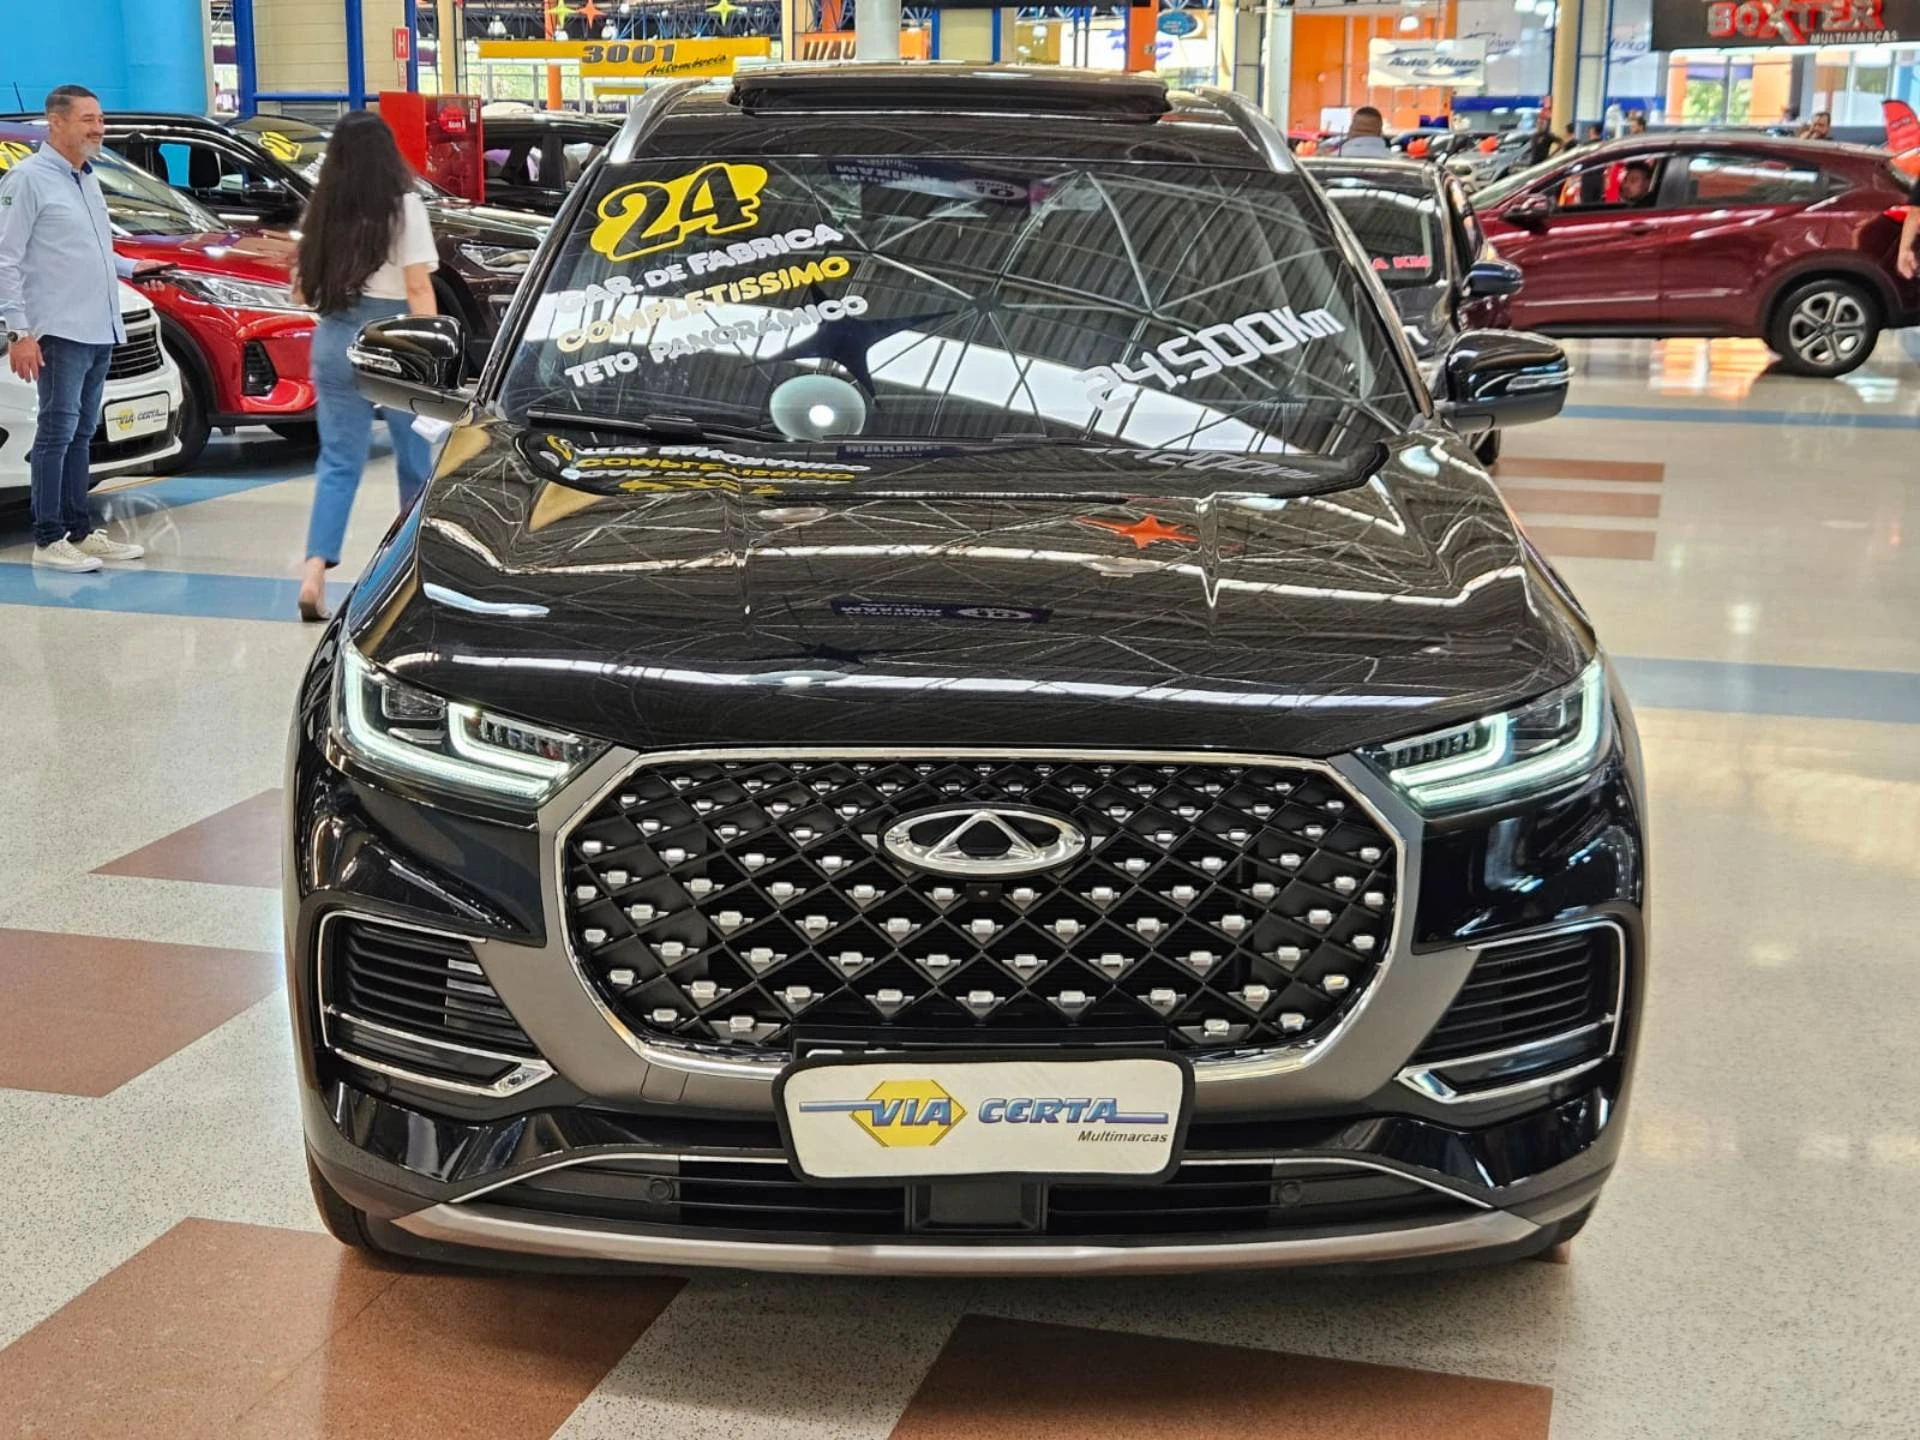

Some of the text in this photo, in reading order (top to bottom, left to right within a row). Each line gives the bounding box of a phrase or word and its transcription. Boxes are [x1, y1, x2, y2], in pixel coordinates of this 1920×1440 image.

[1810, 30, 1900, 44] MULTIMARCAS
[582, 44, 677, 64] 3001
[597, 163, 763, 260] 24
[644, 263, 688, 287] DE
[564, 351, 638, 387] TETO
[871, 1097, 1118, 1127] VIA CERTA
[1077, 1130, 1168, 1143] Multimarcas
